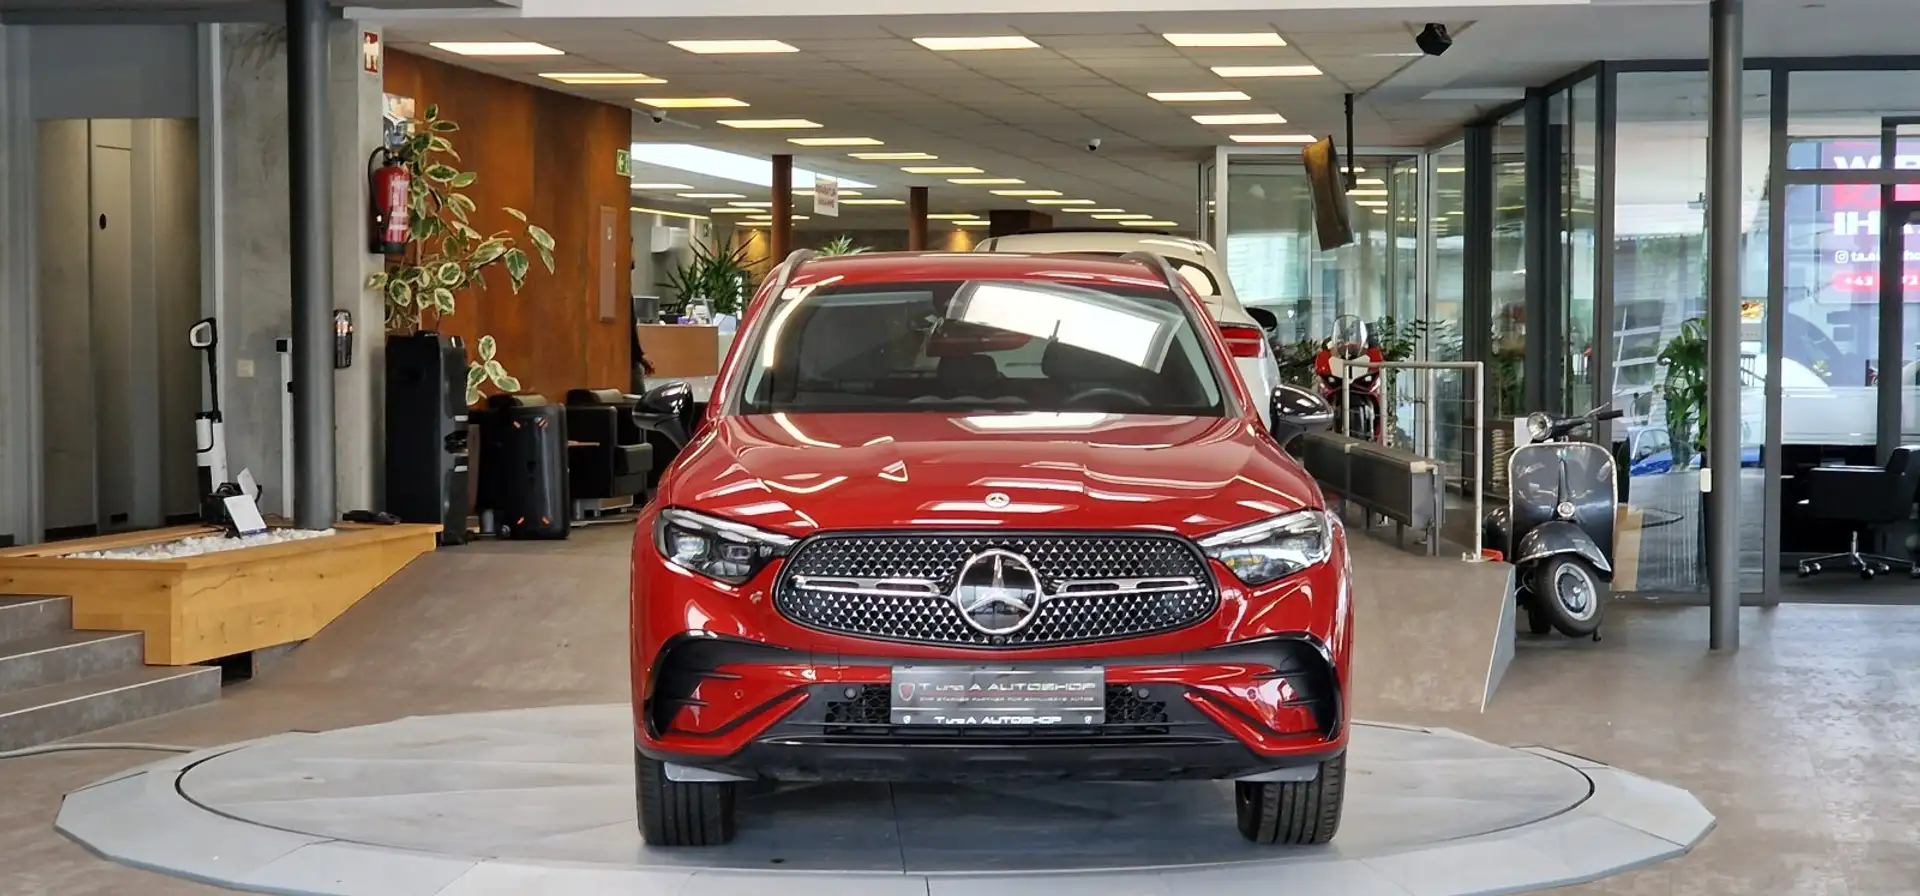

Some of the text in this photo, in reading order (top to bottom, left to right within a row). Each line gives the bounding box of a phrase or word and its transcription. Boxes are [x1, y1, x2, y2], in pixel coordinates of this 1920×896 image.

[919, 682, 931, 691] T
[969, 683, 982, 691] A
[987, 682, 1096, 692] AUTOSHOP
[981, 715, 1063, 725] AUTOSHOP
